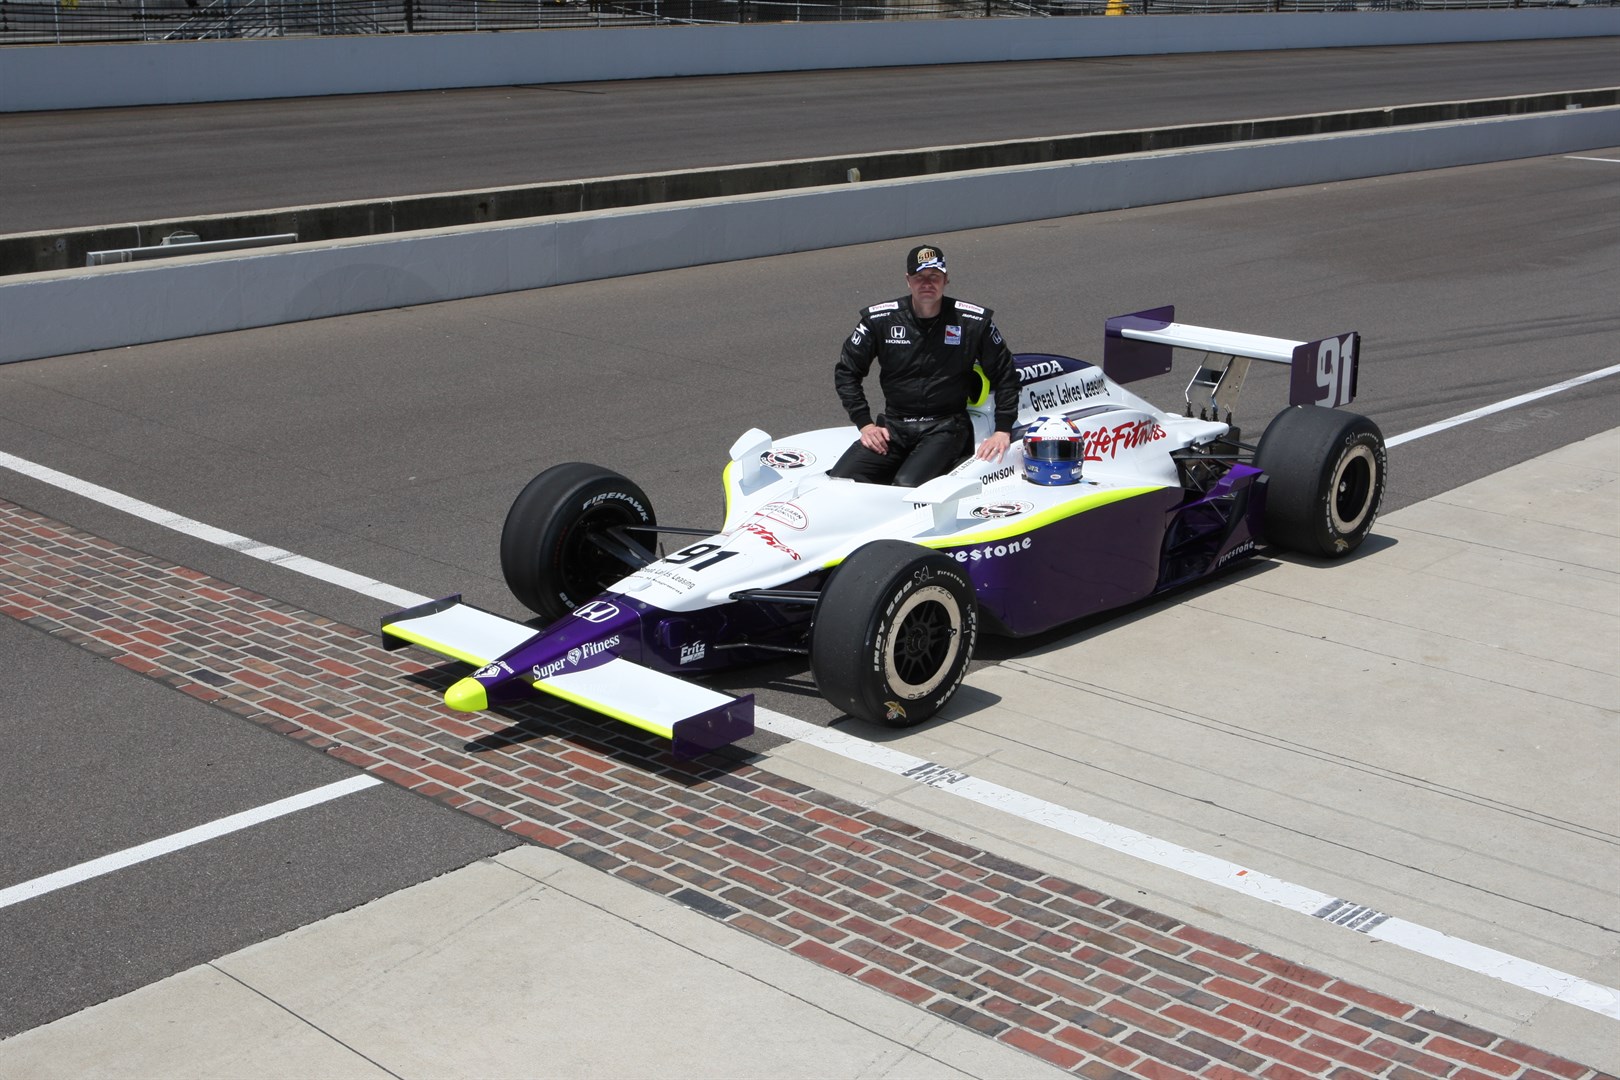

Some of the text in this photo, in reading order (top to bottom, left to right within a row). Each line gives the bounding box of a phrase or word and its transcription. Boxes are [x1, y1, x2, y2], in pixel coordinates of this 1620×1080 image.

[1015, 359, 1064, 382] ONDA
[1315, 333, 1354, 408] 91
[1029, 374, 1110, 413] Great Lakes Leasing
[979, 465, 1015, 485] OHNSON
[583, 491, 649, 522] FIREHAWK
[665, 542, 739, 572] 91
[671, 573, 696, 590] Leasing
[886, 580, 913, 617] 500
[532, 634, 621, 681] Super Fitness
[681, 640, 706, 658] Fritz
